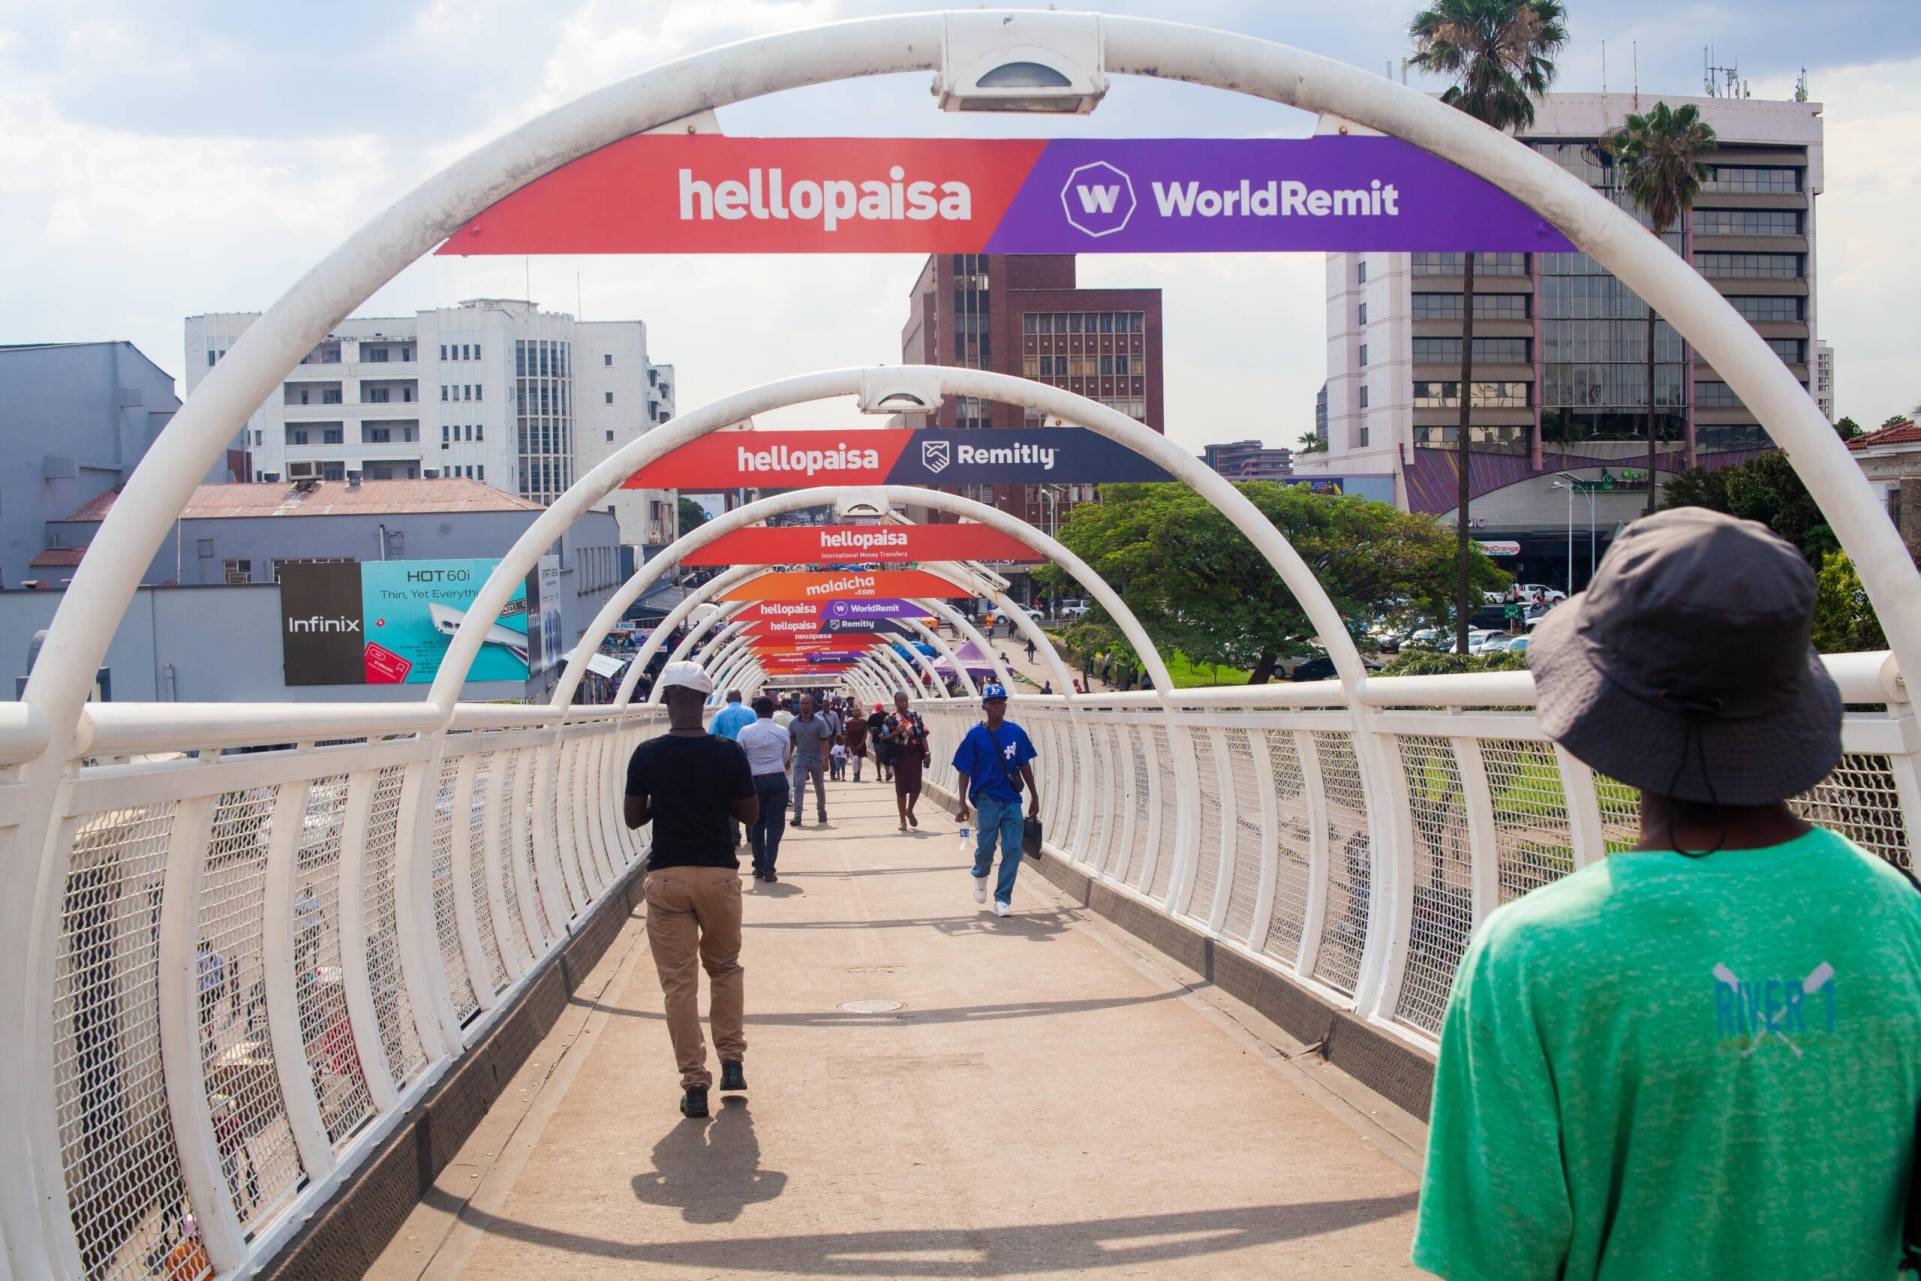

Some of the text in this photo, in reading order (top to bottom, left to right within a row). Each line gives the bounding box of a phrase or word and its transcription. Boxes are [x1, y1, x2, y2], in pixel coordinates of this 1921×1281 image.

[678, 165, 972, 232] hellopaisa
[1151, 179, 1399, 218] WorldRemit
[737, 442, 879, 475] hellopaisa
[957, 442, 1055, 470] Remitly
[821, 529, 908, 550] hellopaisa
[407, 569, 471, 582] HOT 60i
[380, 588, 480, 601] Thin, Yet Everythi
[806, 575, 875, 596] malaicha
[854, 588, 876, 596] .com
[760, 603, 817, 616] hellopaisa
[851, 604, 900, 613] WorldRemit
[288, 615, 361, 633] Infinix
[770, 621, 817, 633] hellopaisa
[841, 619, 875, 630] Remitly
[1715, 979, 1807, 1036] RIVER
